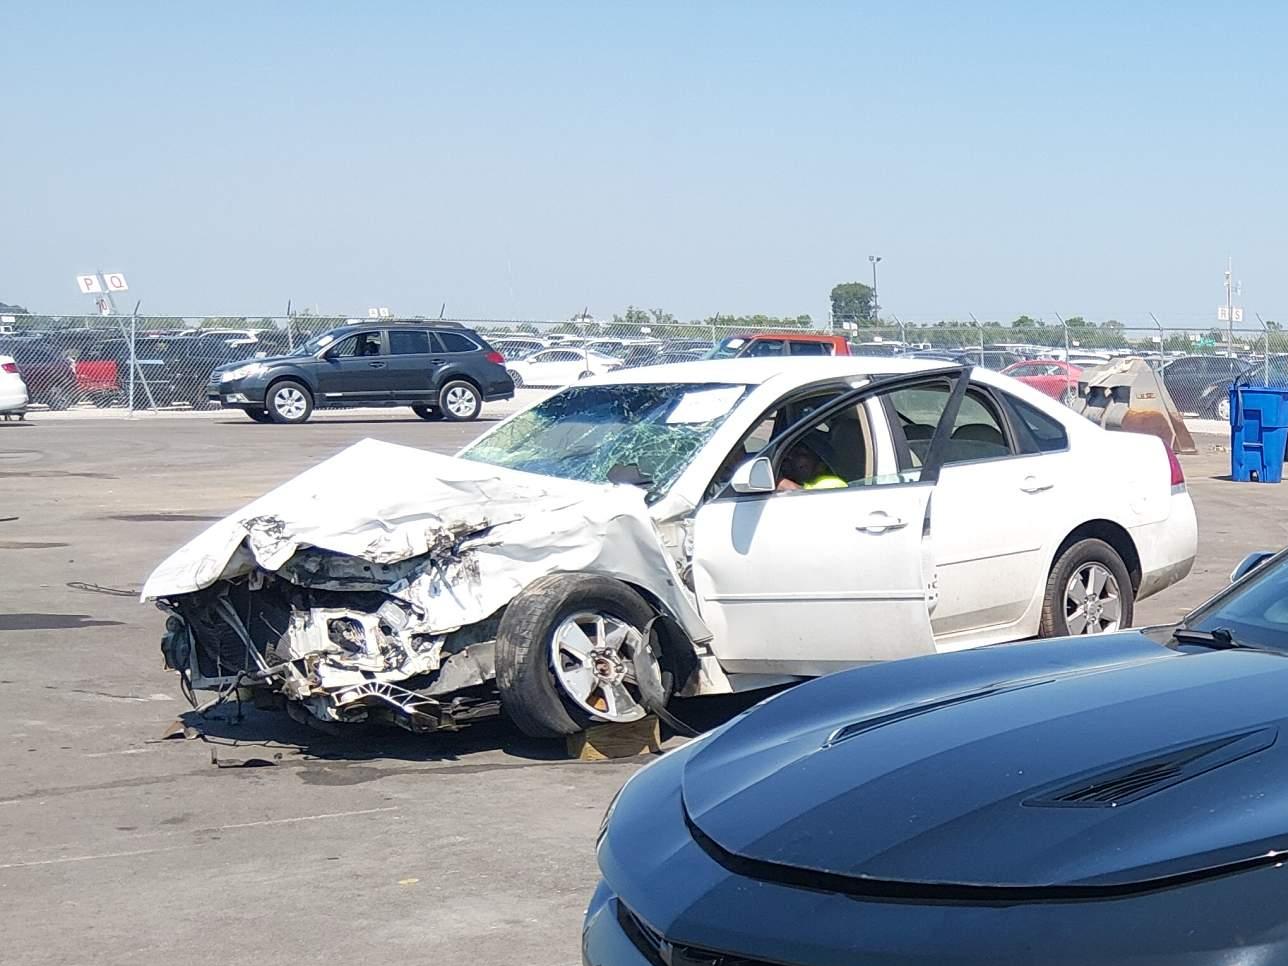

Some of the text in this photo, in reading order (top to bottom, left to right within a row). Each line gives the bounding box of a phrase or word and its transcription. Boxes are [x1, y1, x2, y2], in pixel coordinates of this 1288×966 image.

[83, 277, 93, 291] P
[110, 275, 125, 289] Q
[1234, 310, 1241, 320] S
